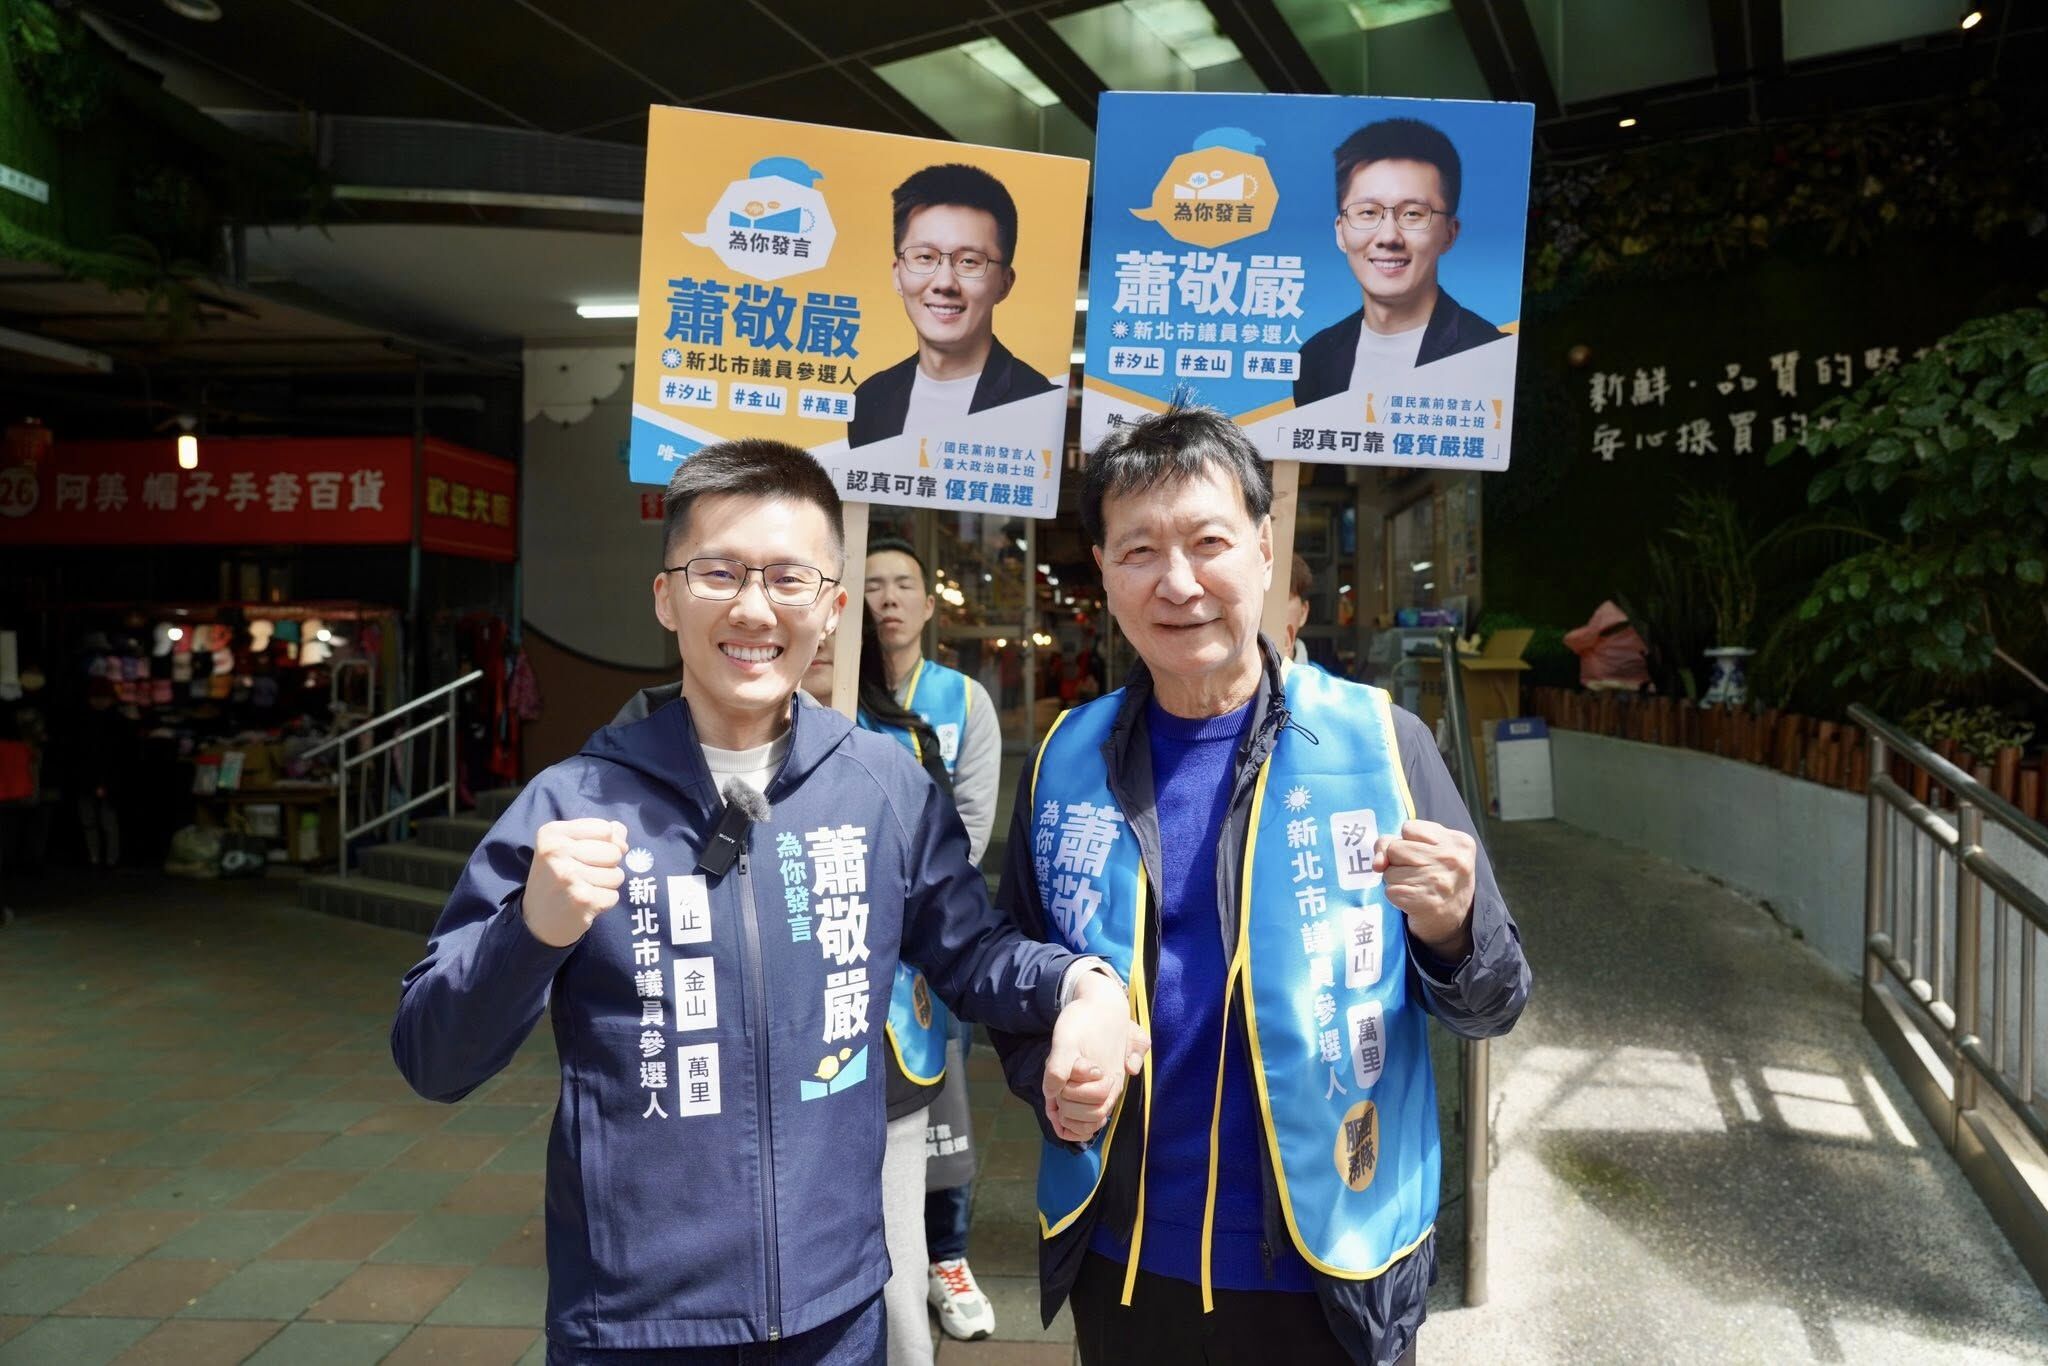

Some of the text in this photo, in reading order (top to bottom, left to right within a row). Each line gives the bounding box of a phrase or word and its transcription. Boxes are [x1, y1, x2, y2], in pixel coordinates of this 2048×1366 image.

[1173, 202, 1255, 223] 為你發言
[729, 231, 811, 258] 為你發言
[1112, 250, 1305, 319] 蕭敬嚴
[664, 277, 861, 359] 蕭敬嚴
[1133, 320, 1303, 345] 新北市議員參選人
[686, 350, 858, 386] 新北市議員參選人
[1114, 352, 1294, 374] #汐止 #金山 #萬里
[665, 382, 849, 415] #汐止 #金山 #萬里
[1035, 800, 1060, 911] 為你發言
[1341, 824, 1373, 875] 汐止
[776, 831, 812, 943] 為你發言
[805, 824, 871, 1044] 蕭敬嚴
[1286, 816, 1347, 1101] 新北市議員參選人
[1353, 919, 1374, 975] 金山
[628, 877, 669, 1120] 新北市議員參選人
[684, 969, 707, 1018] 金山
[1356, 1016, 1381, 1075] 萬里
[688, 1056, 711, 1104] 萬里
